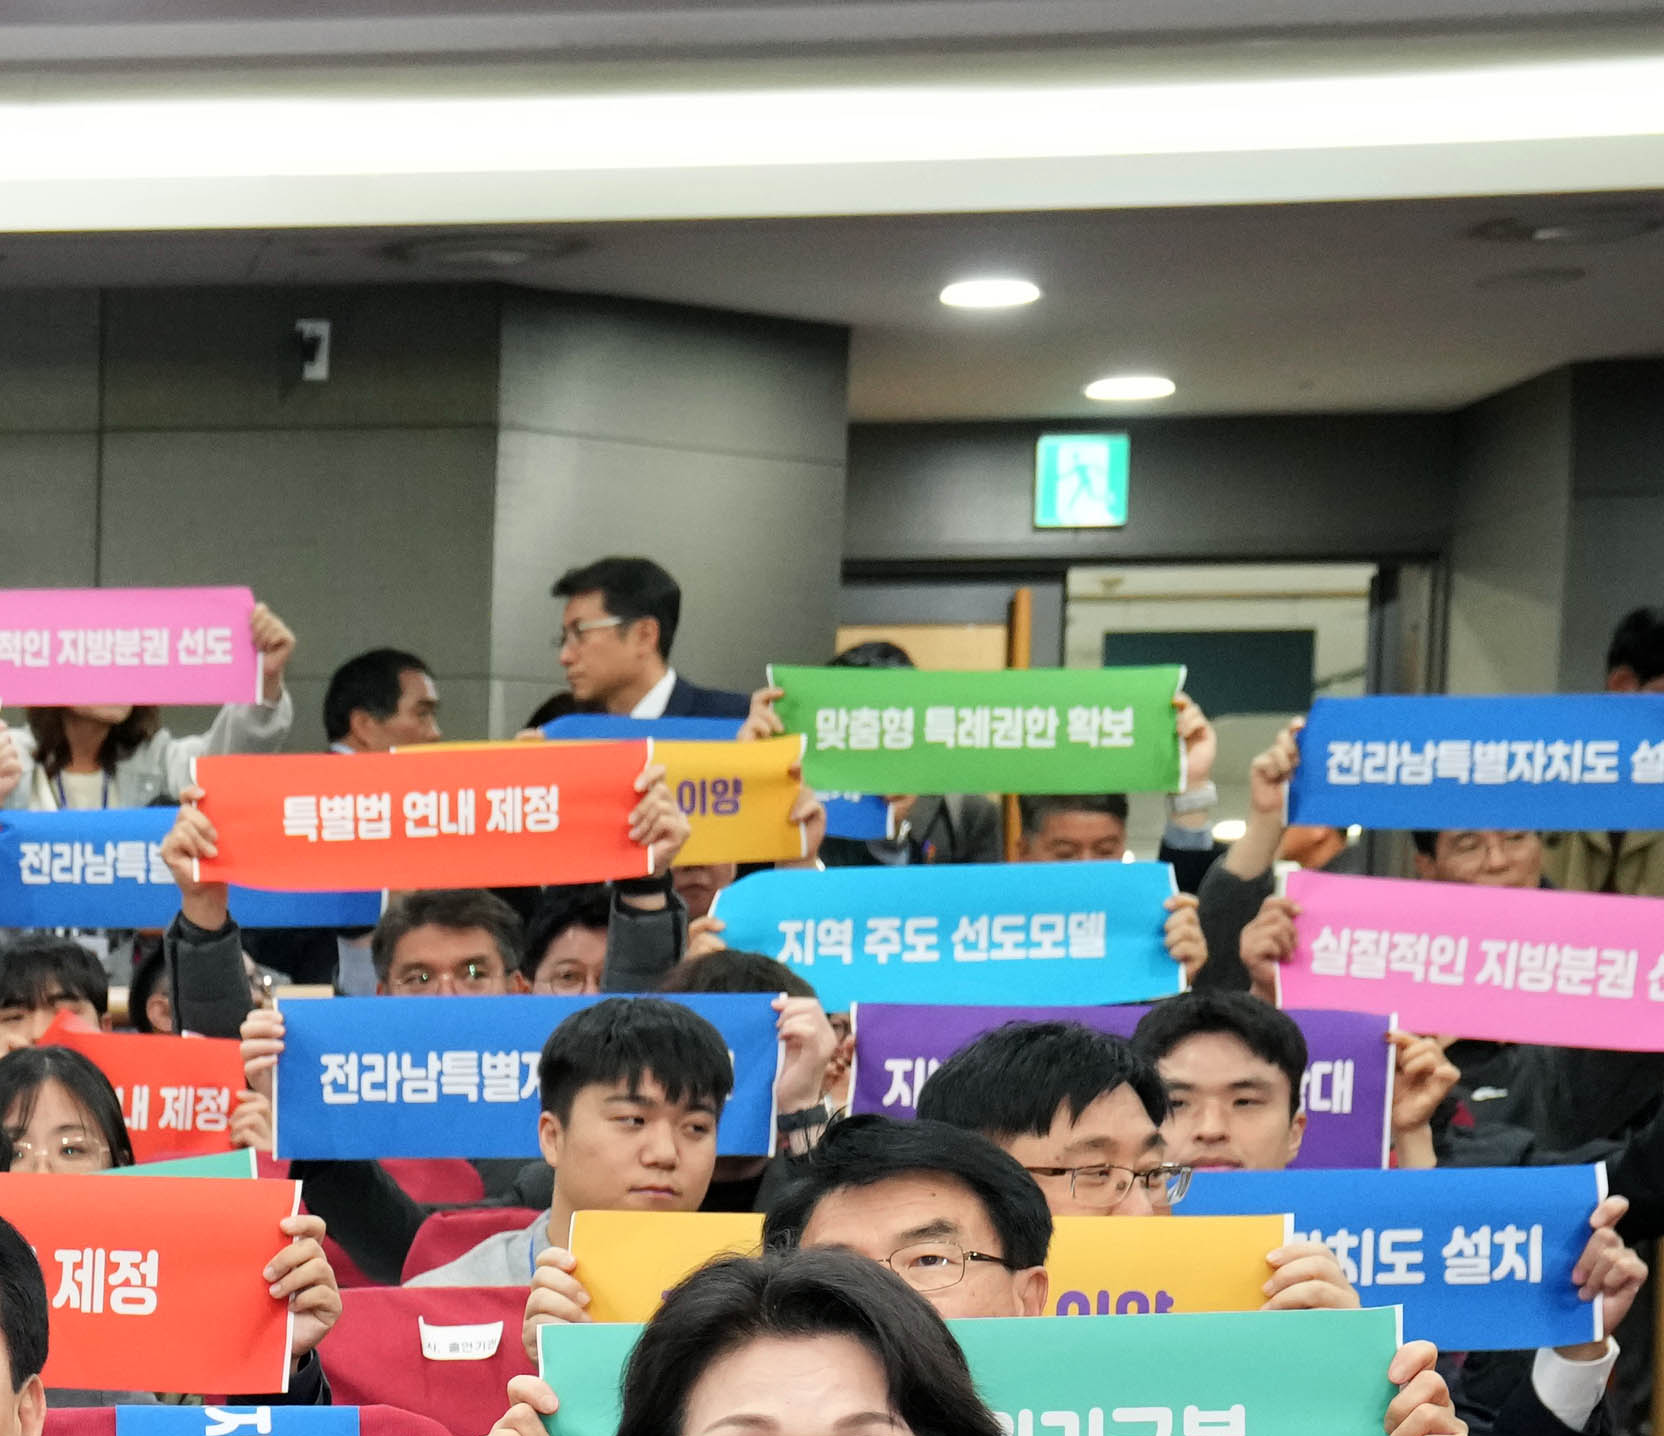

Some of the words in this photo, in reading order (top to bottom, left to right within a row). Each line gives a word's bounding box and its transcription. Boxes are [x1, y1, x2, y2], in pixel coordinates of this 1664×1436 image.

[58, 628, 170, 667] 지방분권
[177, 627, 233, 665] 선도
[816, 707, 914, 749] 맞춤형
[924, 706, 1060, 749] 특례권한
[1068, 706, 1134, 748] 확보
[1327, 740, 1619, 785] 전라남특별자치도
[283, 795, 391, 842] 특별법
[403, 789, 474, 838] 연내
[486, 785, 559, 833] 제정
[677, 778, 742, 815] 이양
[778, 918, 853, 965] 지역
[863, 916, 939, 963] 주도
[951, 911, 1106, 961] 선도모델
[1311, 926, 1469, 986] 실질적인
[1475, 939, 1638, 999] 지방분권
[158, 1085, 230, 1131] 제정
[1299, 1060, 1353, 1113] 대
[52, 1247, 159, 1315] 제정
[1442, 1224, 1543, 1285] 설치
